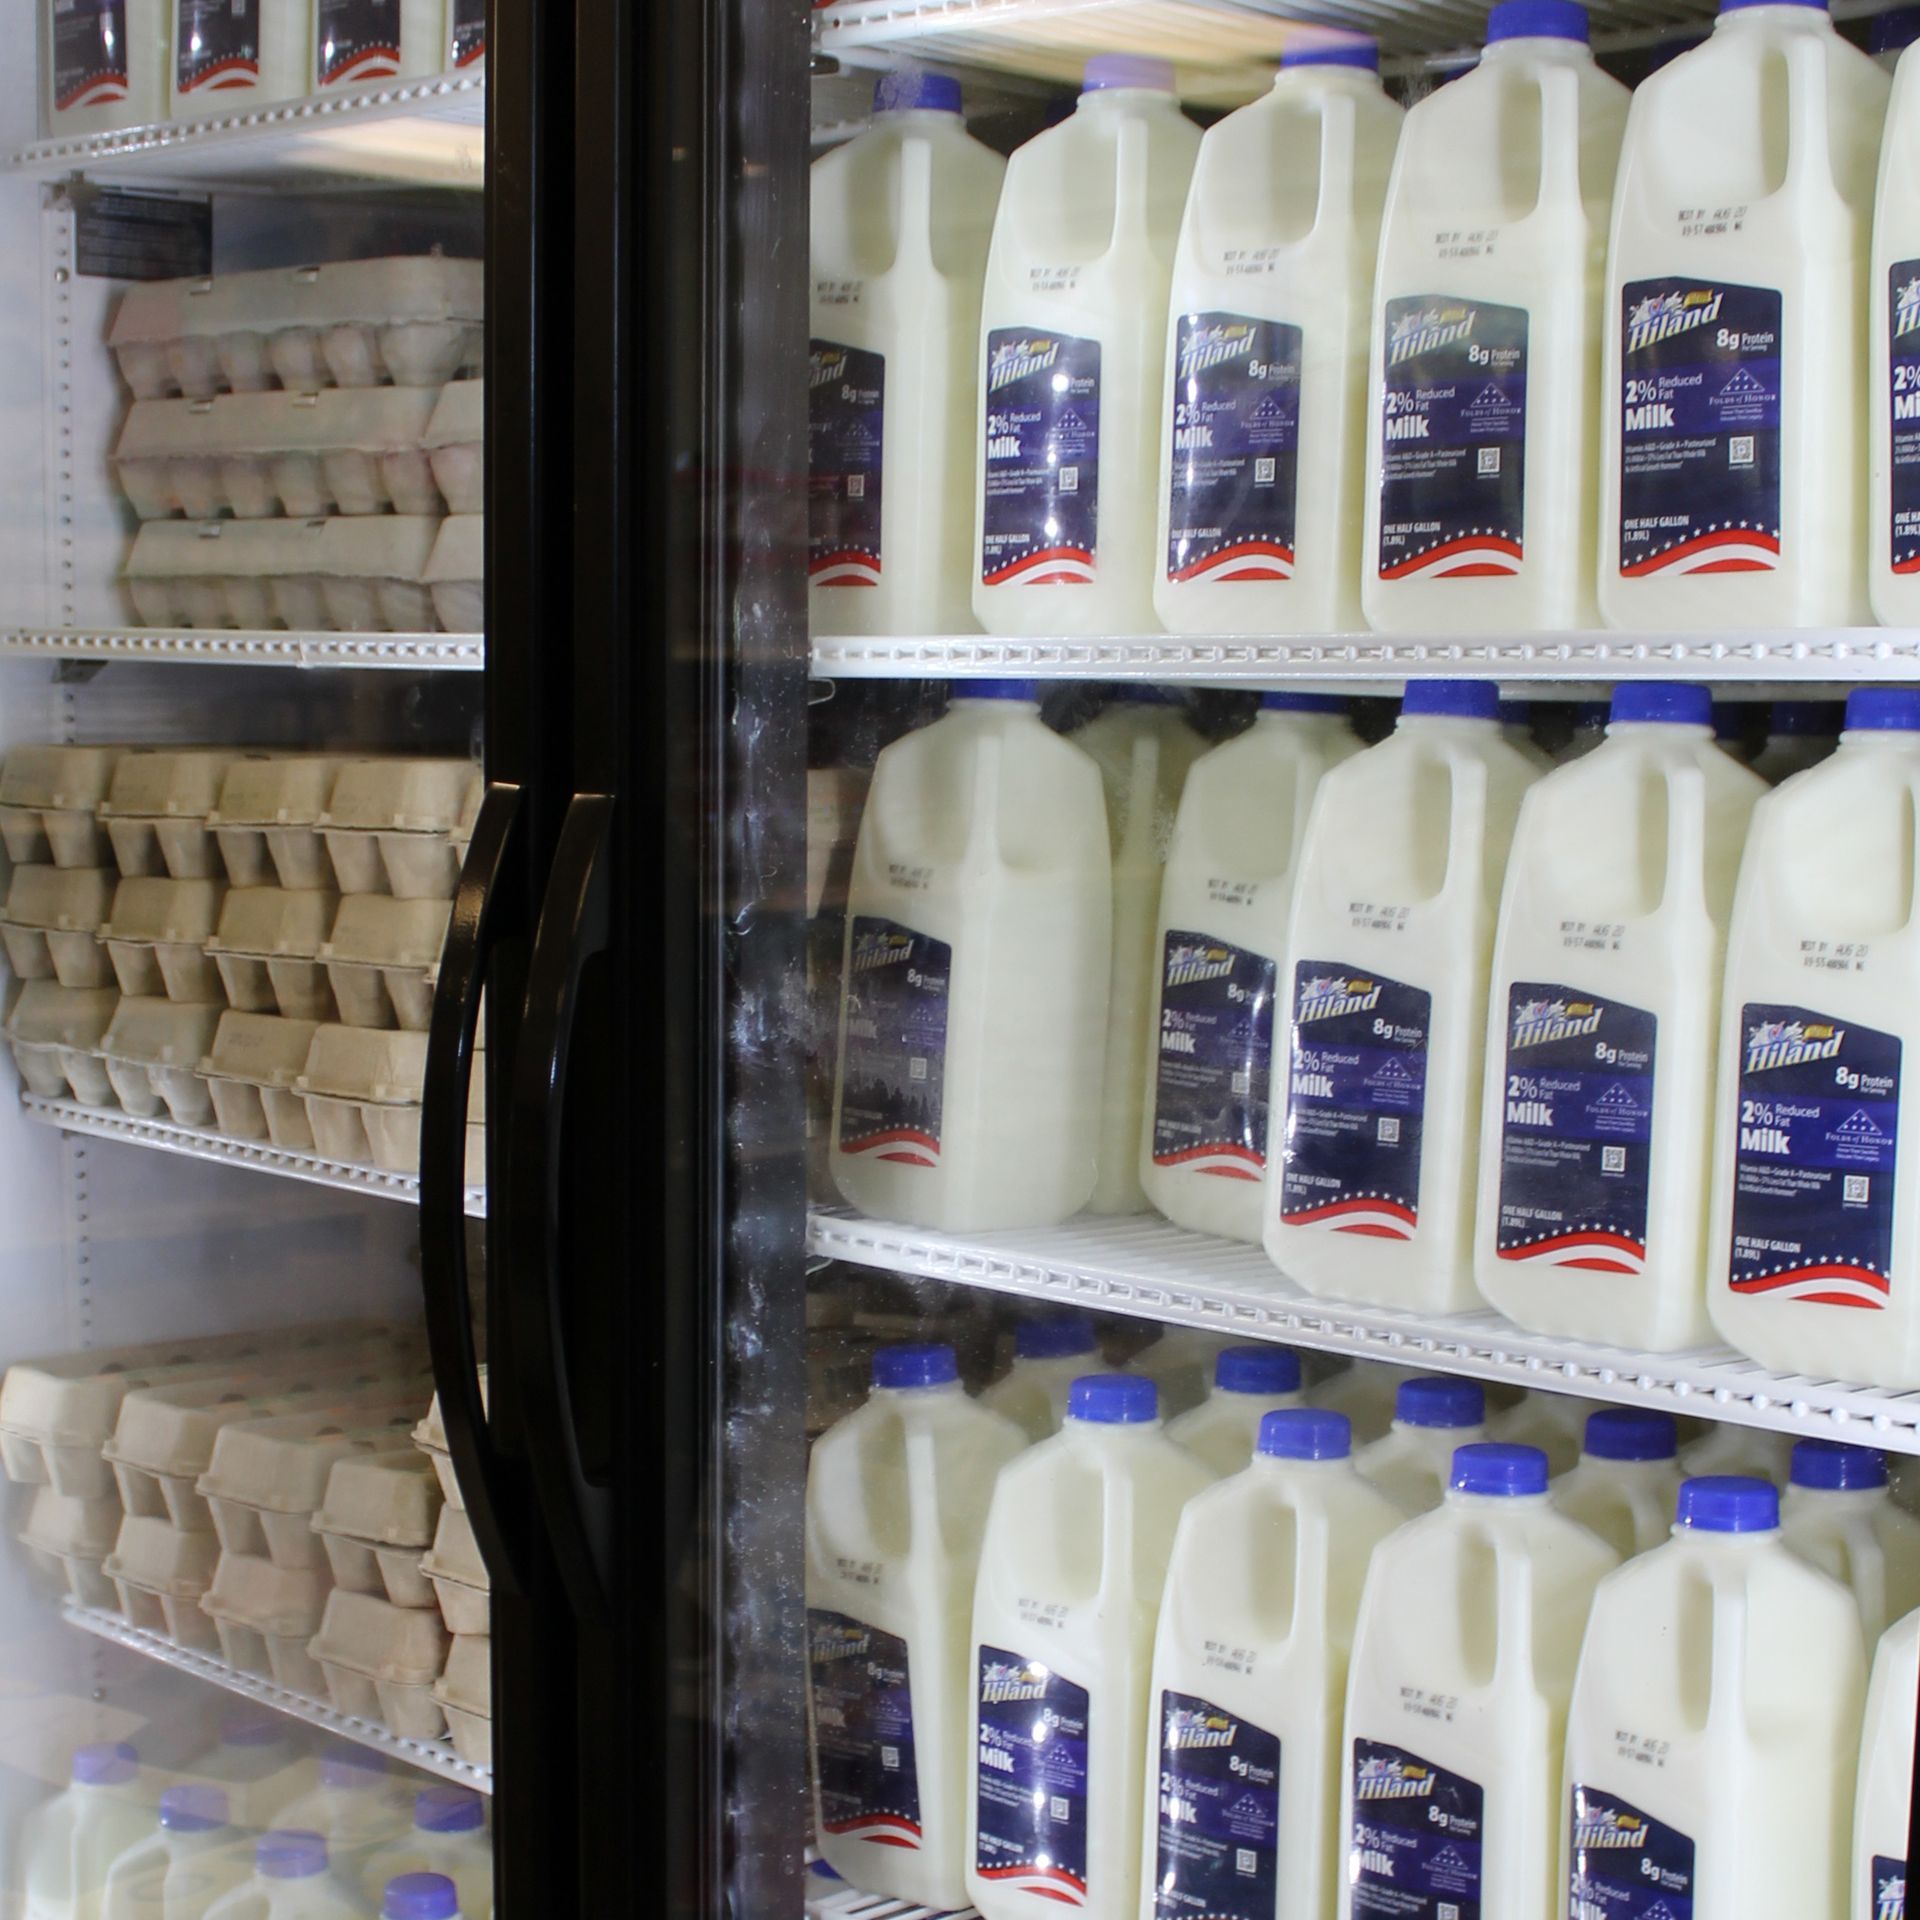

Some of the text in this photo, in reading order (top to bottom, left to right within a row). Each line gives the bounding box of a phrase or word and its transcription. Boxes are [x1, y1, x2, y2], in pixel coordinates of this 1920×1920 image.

[1628, 293, 1724, 354] Hiland
[1390, 311, 1476, 367] Hiland
[1717, 329, 1774, 349] 8g Protein
[1469, 345, 1520, 365] 8g Protein
[1249, 360, 1267, 379] 8g
[842, 384, 857, 402] 8g
[1386, 386, 1455, 414] 2% Reduced
[1626, 373, 1703, 404] 2% Reduced
[1658, 389, 1674, 400] Fat
[1176, 401, 1236, 425] 2% Reduced
[1415, 400, 1429, 411] Fat
[989, 412, 1041, 435] 2% Reduced
[1386, 415, 1429, 440] Milk
[1625, 404, 1674, 431] Milk
[988, 436, 1020, 459] Milk
[1176, 426, 1213, 449] Milk
[1398, 523, 1413, 533] HALF
[1414, 521, 1441, 533] GALLON
[1624, 515, 1689, 529] ONE HALF GALLON
[907, 968, 922, 987] 8g
[1167, 954, 1236, 986] Hiland
[1228, 983, 1244, 1002] 8g
[1297, 985, 1382, 1025] Hiland
[1163, 1009, 1184, 1029] 2%
[1373, 1018, 1422, 1039] 8g Protein
[1512, 1008, 1603, 1050] Hiland
[1162, 1031, 1196, 1053] Milk
[1595, 1042, 1648, 1064] 8g Protein
[1744, 1031, 1845, 1075] Hiland
[1293, 1050, 1360, 1072] 2% Reduced
[1321, 1064, 1334, 1073] Fat
[1292, 1074, 1334, 1098] Milk
[1508, 1075, 1581, 1099] 2% Reduced
[1835, 1066, 1893, 1089] 8g Protein
[1539, 1090, 1554, 1100] Fat
[1507, 1101, 1553, 1126] Milk
[1741, 1100, 1820, 1125] 2% Reduced
[1774, 1116, 1791, 1127] Fat
[1741, 1127, 1791, 1154] Milk
[1315, 1177, 1341, 1188] GALLON
[1517, 1207, 1534, 1217] HALF
[1535, 1209, 1563, 1221] GALLON
[1735, 1236, 1801, 1253] ONE HALF GALLON
[1043, 1708, 1060, 1727] 8g
[980, 1724, 1002, 1747] 2%
[980, 1746, 1014, 1773] Milk
[1230, 1755, 1249, 1776] 8g
[1161, 1772, 1219, 1796] 2% Reduced
[1358, 1774, 1436, 1799] Hiland
[1161, 1794, 1197, 1823] Mlk
[1429, 1805, 1477, 1829] 8g Protein
[1355, 1823, 1418, 1848] 2% Reduced
[1573, 1824, 1649, 1848] Hiland
[1641, 1858, 1688, 1885] 8g Protein
[1571, 1873, 1594, 1899] 2%
